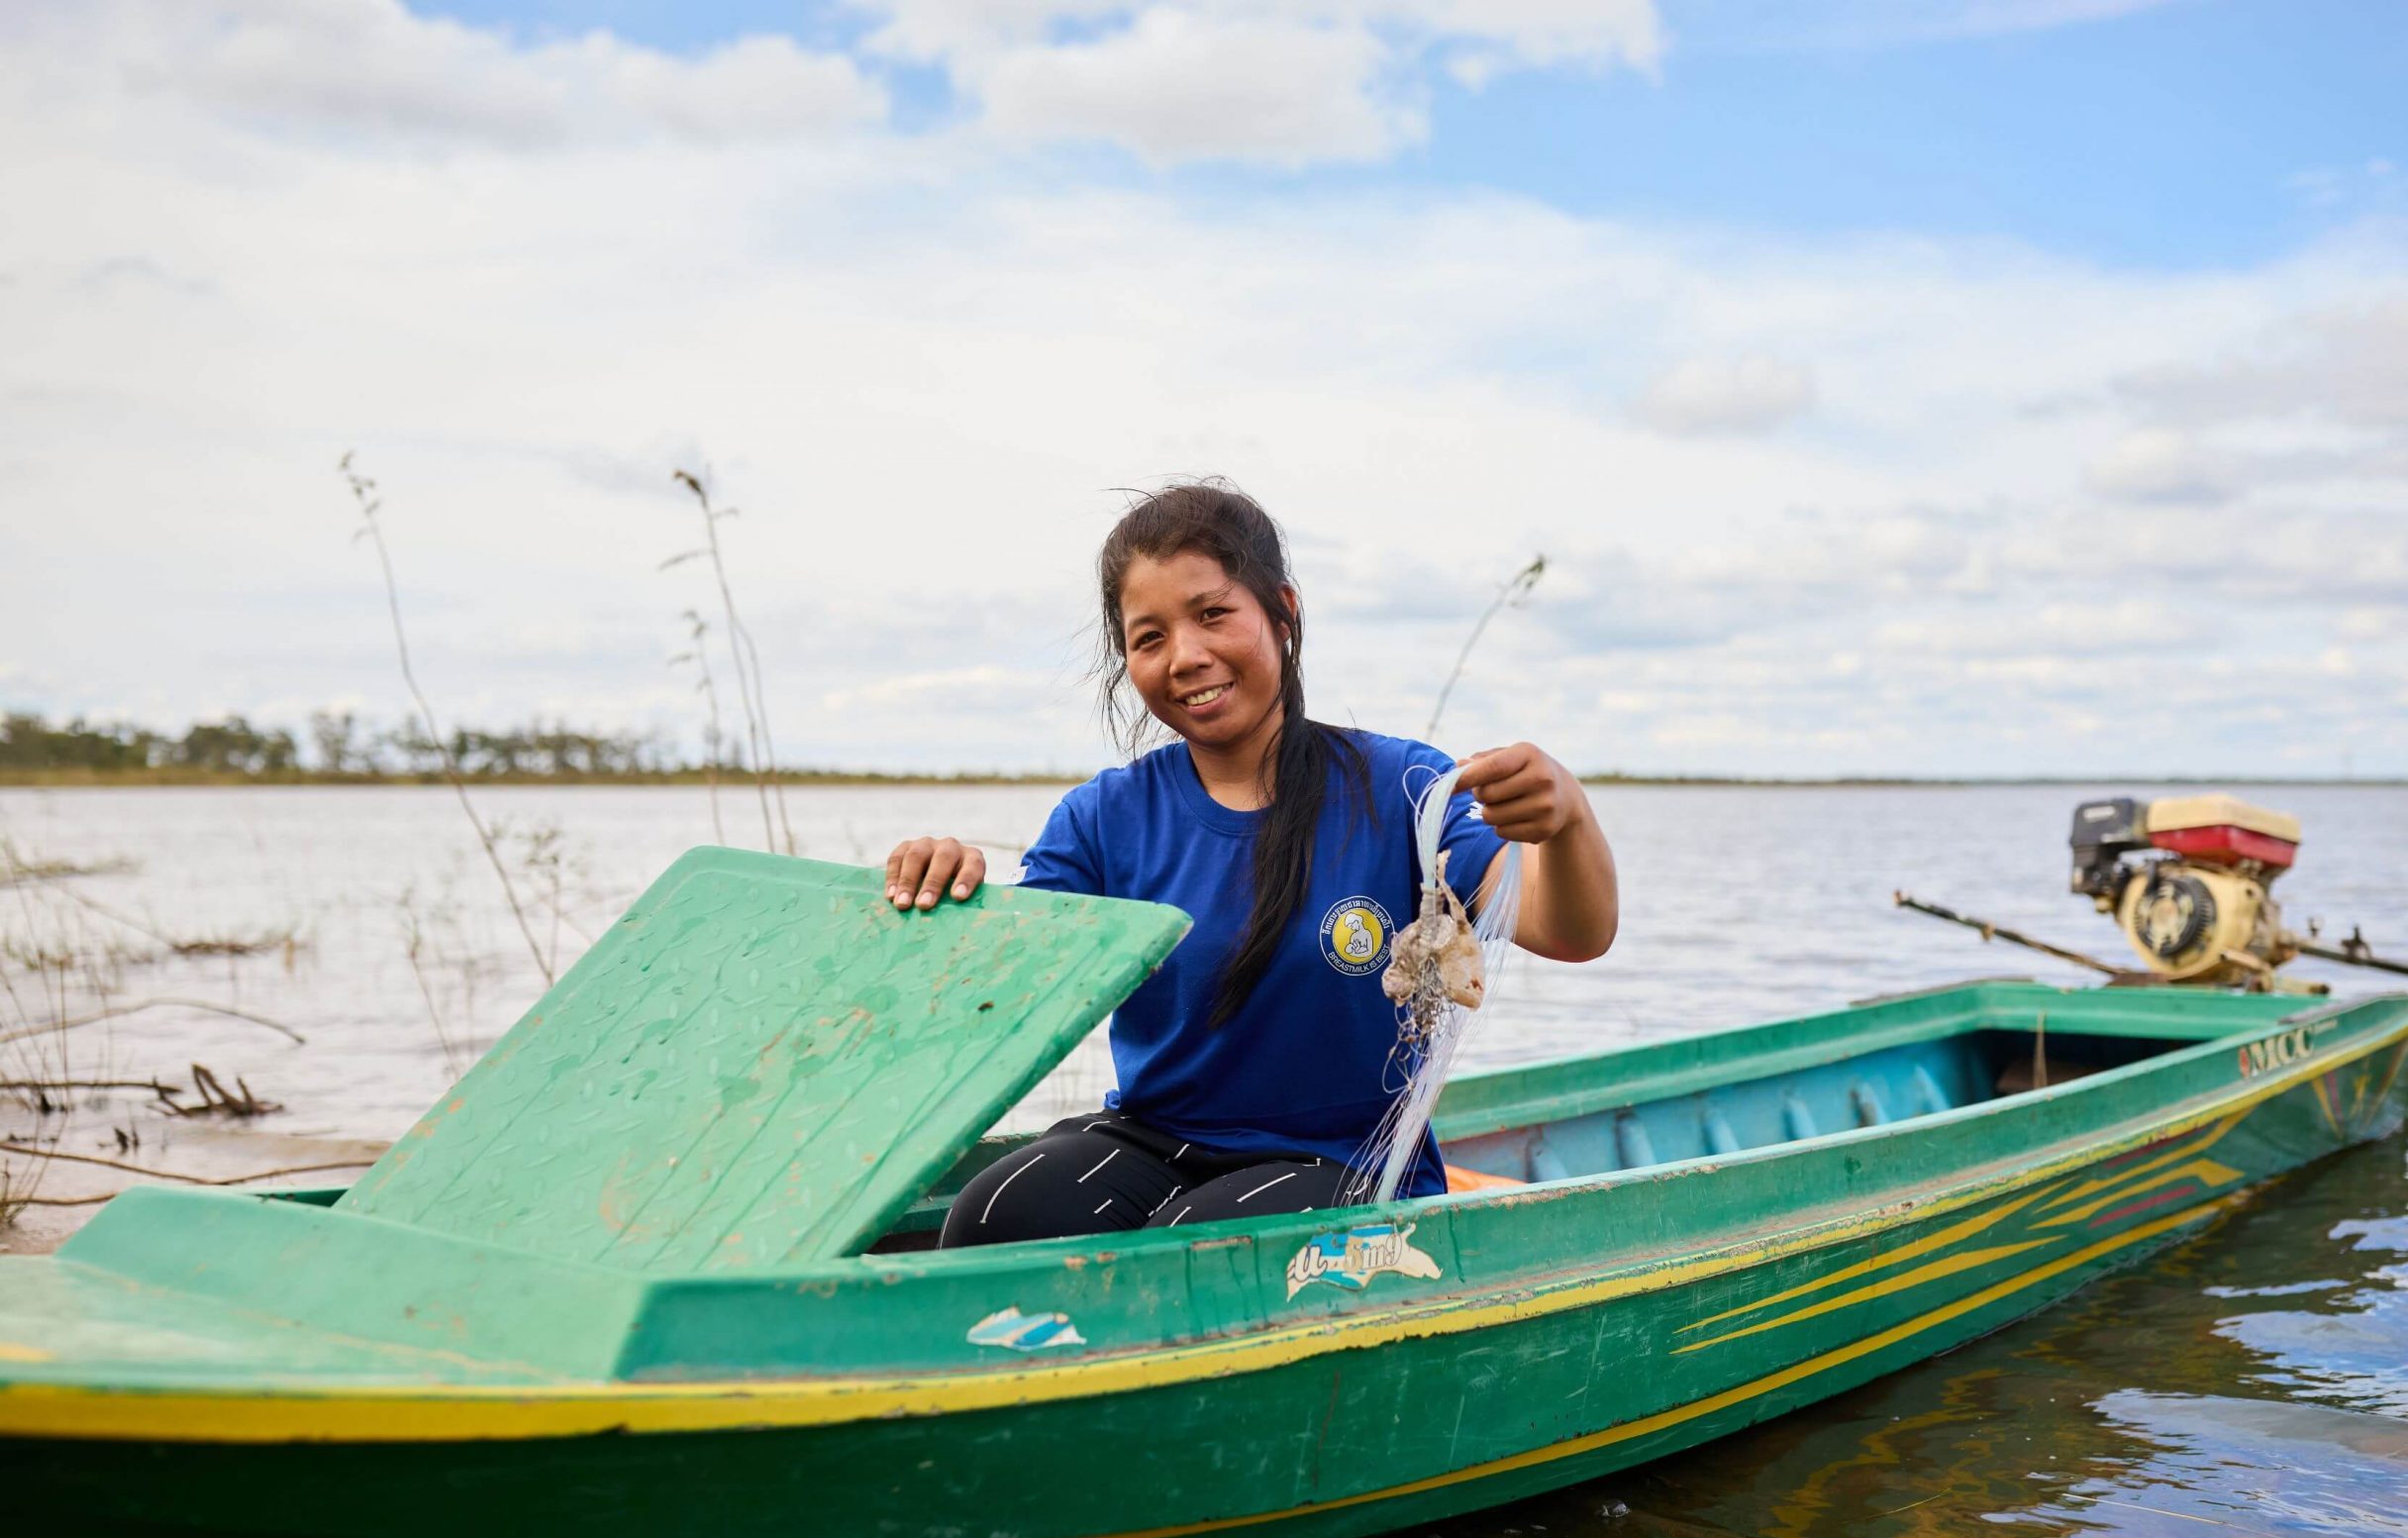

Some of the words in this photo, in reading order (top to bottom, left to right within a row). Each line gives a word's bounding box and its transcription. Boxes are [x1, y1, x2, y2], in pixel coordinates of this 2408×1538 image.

[1328, 951, 1369, 973] BREASTMILK
[1369, 960, 1377, 969] IS
[1375, 943, 1390, 964] BEST
